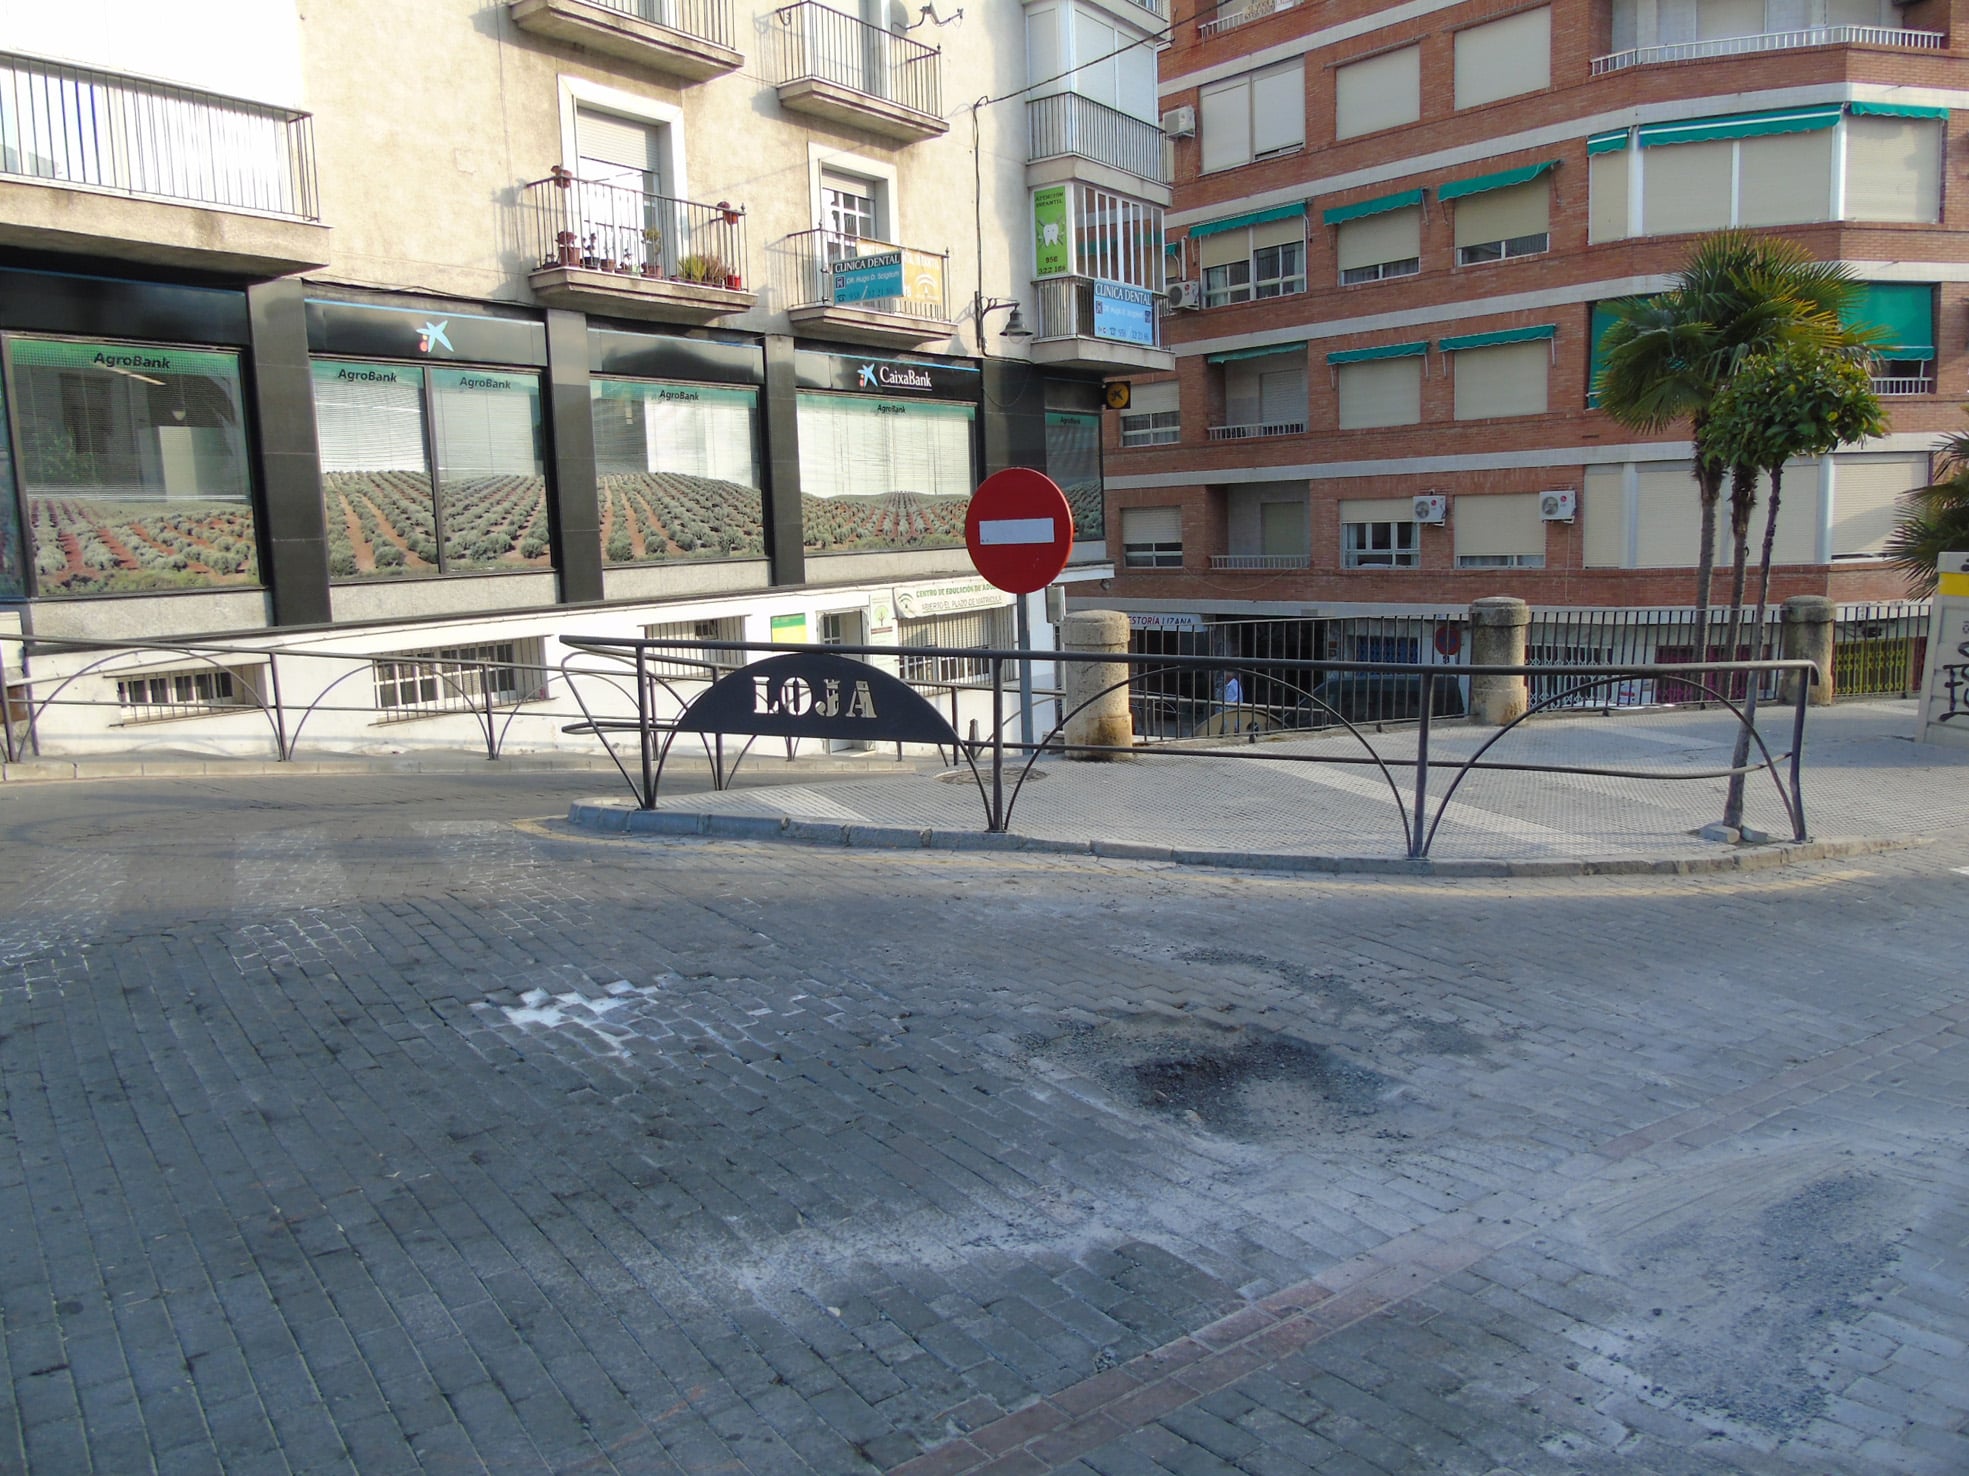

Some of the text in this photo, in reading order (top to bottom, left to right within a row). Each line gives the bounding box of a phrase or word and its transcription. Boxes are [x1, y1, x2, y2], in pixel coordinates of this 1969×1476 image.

[835, 260, 866, 273] CLINICA
[867, 254, 900, 268] DENTAL
[1095, 283, 1152, 305] CLINICA DENTAL
[94, 352, 170, 368] AgroBank
[338, 369, 397, 383] AgroBank
[460, 377, 511, 389] AgroBank
[880, 366, 932, 387] CaixaBank
[659, 389, 699, 401] AgroBank
[877, 404, 906, 414] AgroBank
[1060, 416, 1080, 426] AgroBank
[916, 588, 937, 598] CENTRO
[974, 584, 982, 593] DE
[1128, 616, 1160, 625] ESTORÍA
[753, 676, 877, 718] LOJA
